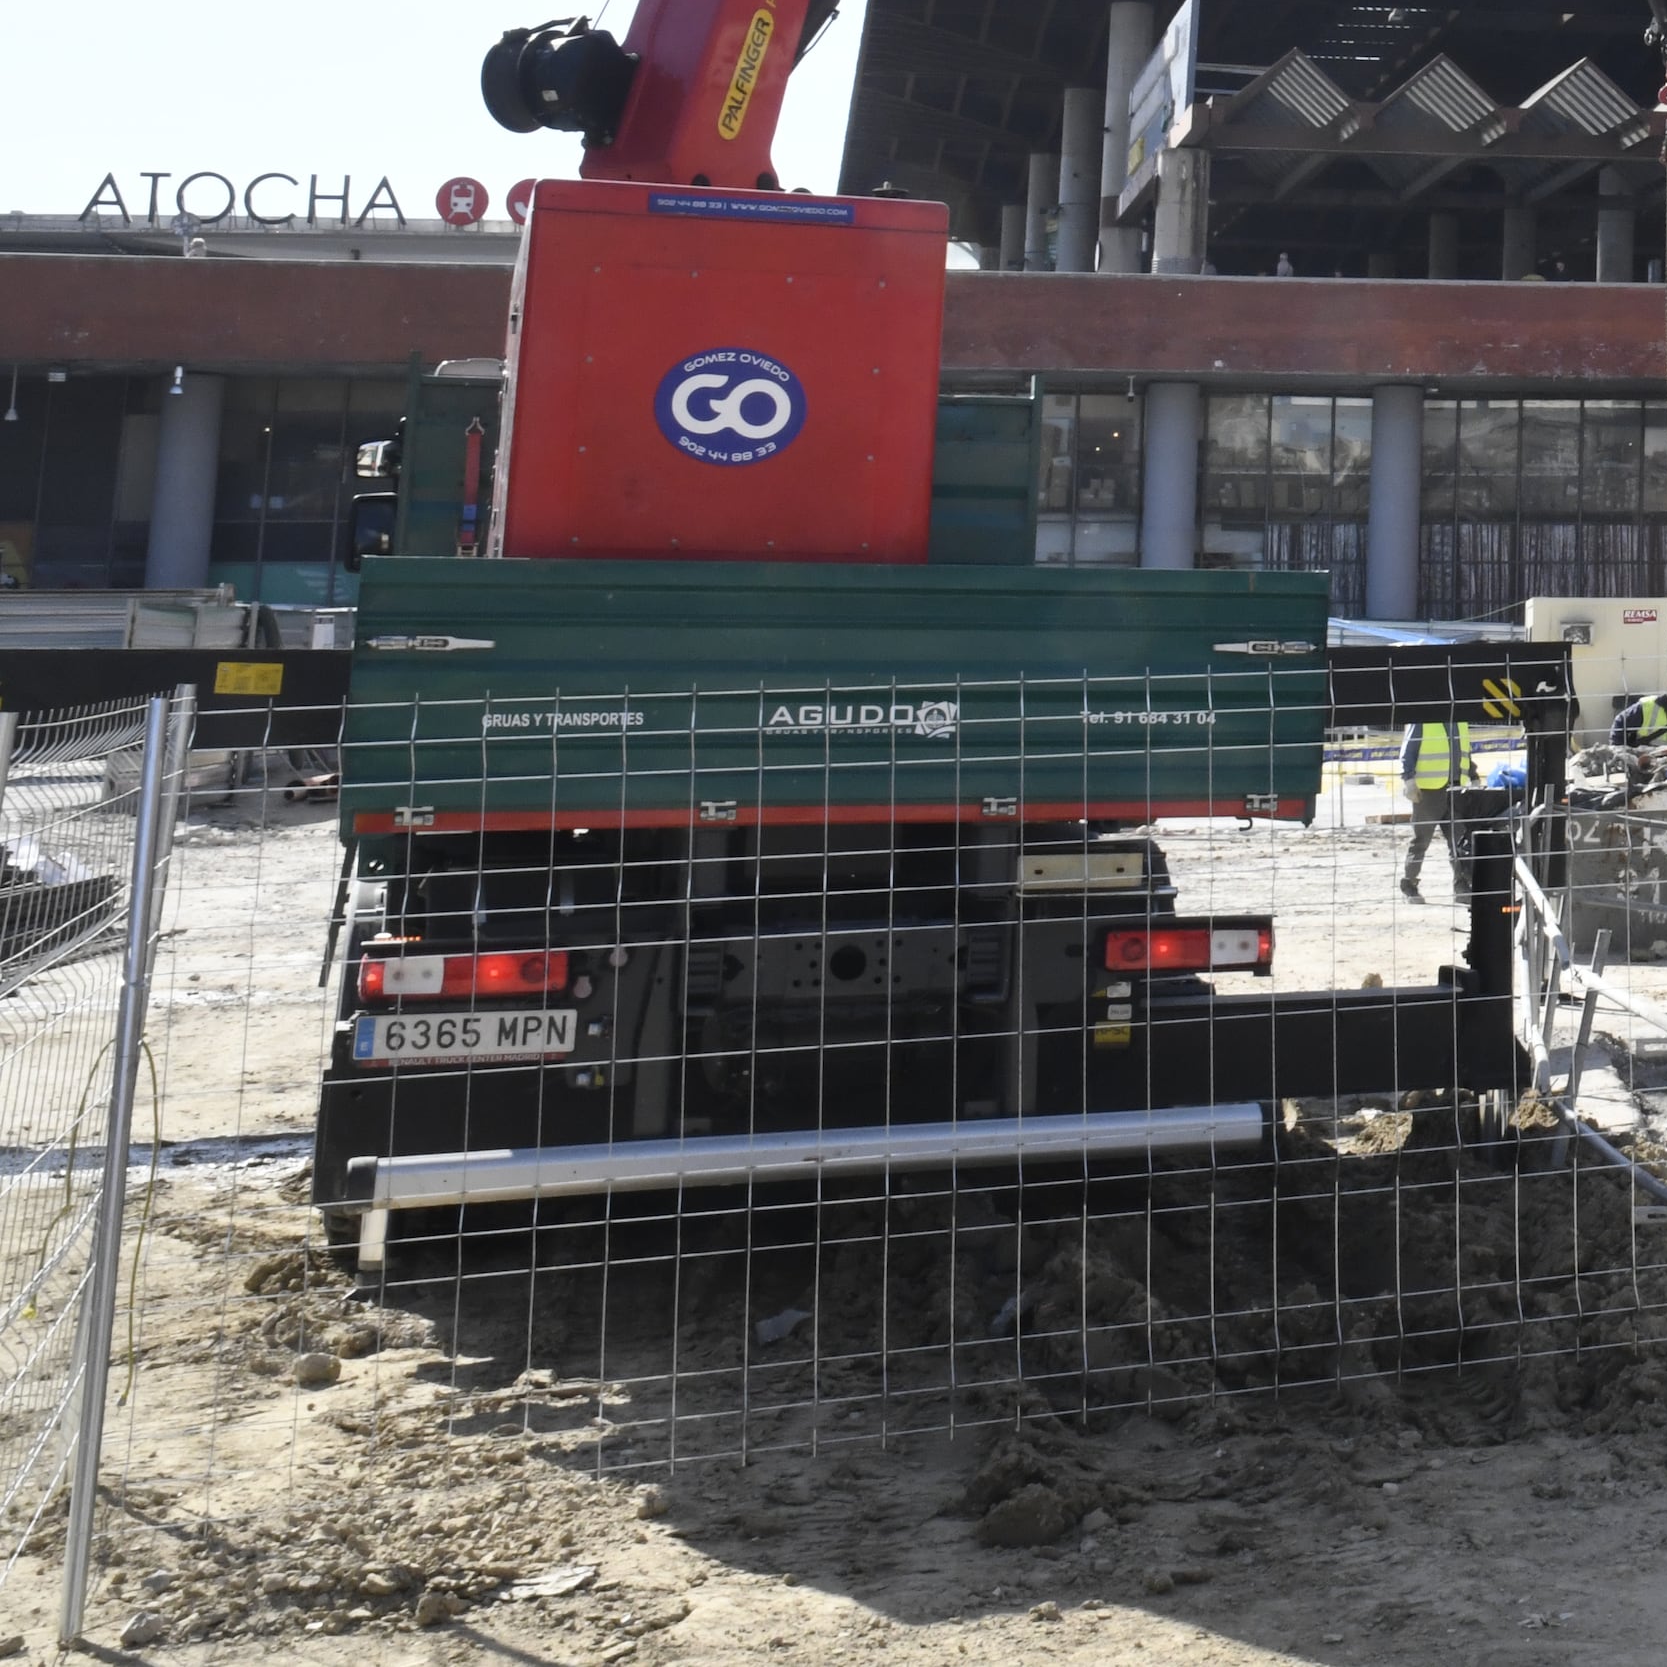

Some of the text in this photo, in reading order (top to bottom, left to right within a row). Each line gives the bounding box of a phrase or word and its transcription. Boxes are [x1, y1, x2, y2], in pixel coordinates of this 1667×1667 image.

[721, 16, 771, 133] PALFINGER
[78, 172, 407, 227] ATOCHA
[684, 352, 790, 382] GOMEZ OVIEDO
[671, 373, 792, 439] GO
[678, 436, 777, 462] 902 44 88 33
[482, 712, 644, 727] GRUAS Y TRANSPORTES
[769, 705, 914, 726] AGUDO
[1080, 710, 1109, 724] Tel.
[1114, 711, 1131, 724] 91
[1173, 712, 1190, 724] 31
[385, 1015, 568, 1051] 6365 MPN
[503, 1052, 541, 1062] MADRID
